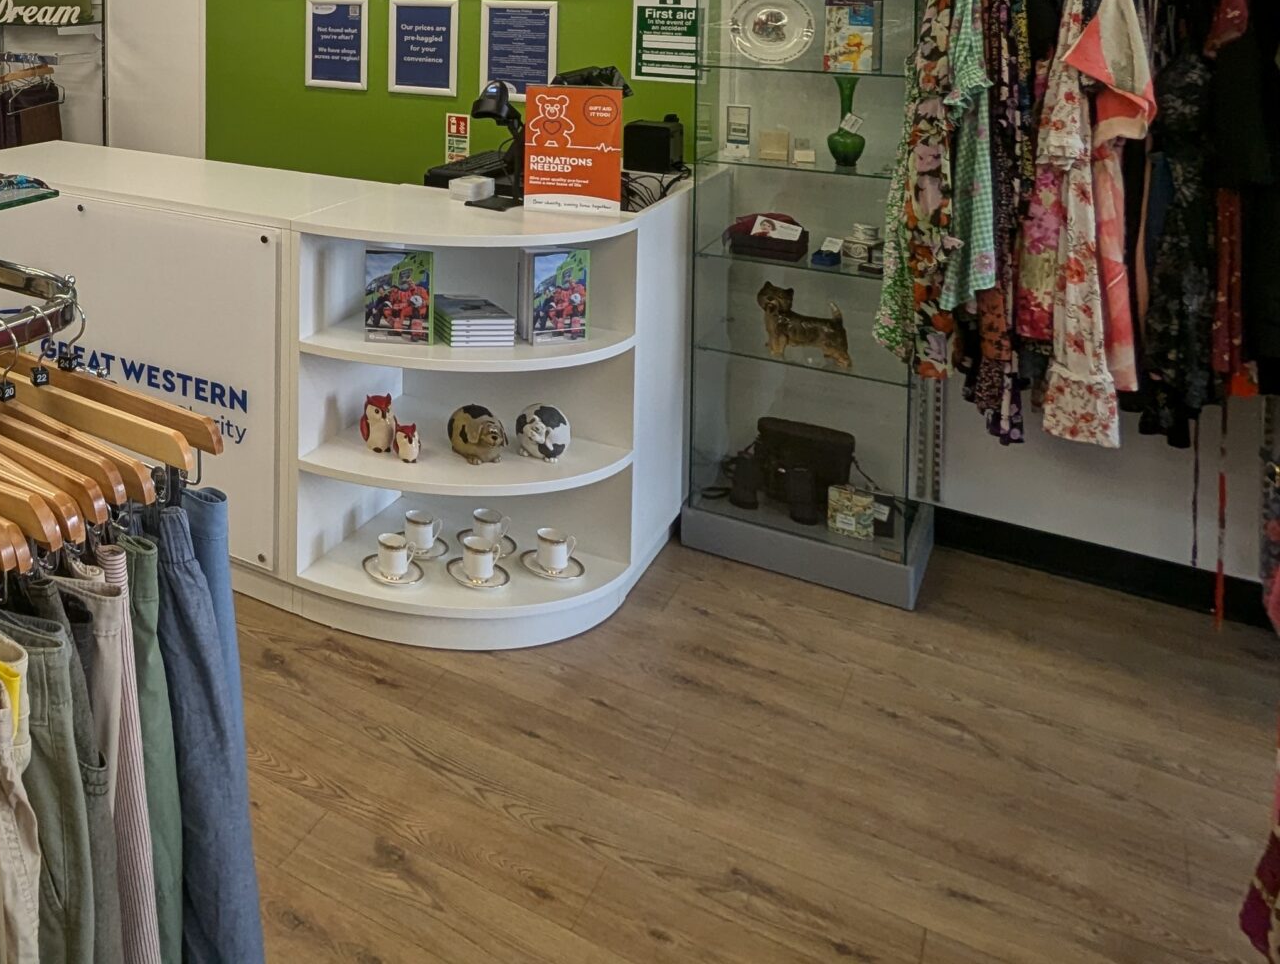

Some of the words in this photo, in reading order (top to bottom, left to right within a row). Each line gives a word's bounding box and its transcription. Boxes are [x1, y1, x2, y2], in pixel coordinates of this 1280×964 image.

[645, 8, 673, 19] First
[676, 9, 696, 20] aid
[414, 24, 434, 32] prices
[404, 34, 443, 43] pre-haggled
[530, 155, 593, 167] DONATIONS
[530, 164, 572, 173] NEEDED
[37, 374, 47, 382] 22
[120, 357, 249, 414] WESTERN
[4, 387, 14, 397] 20
